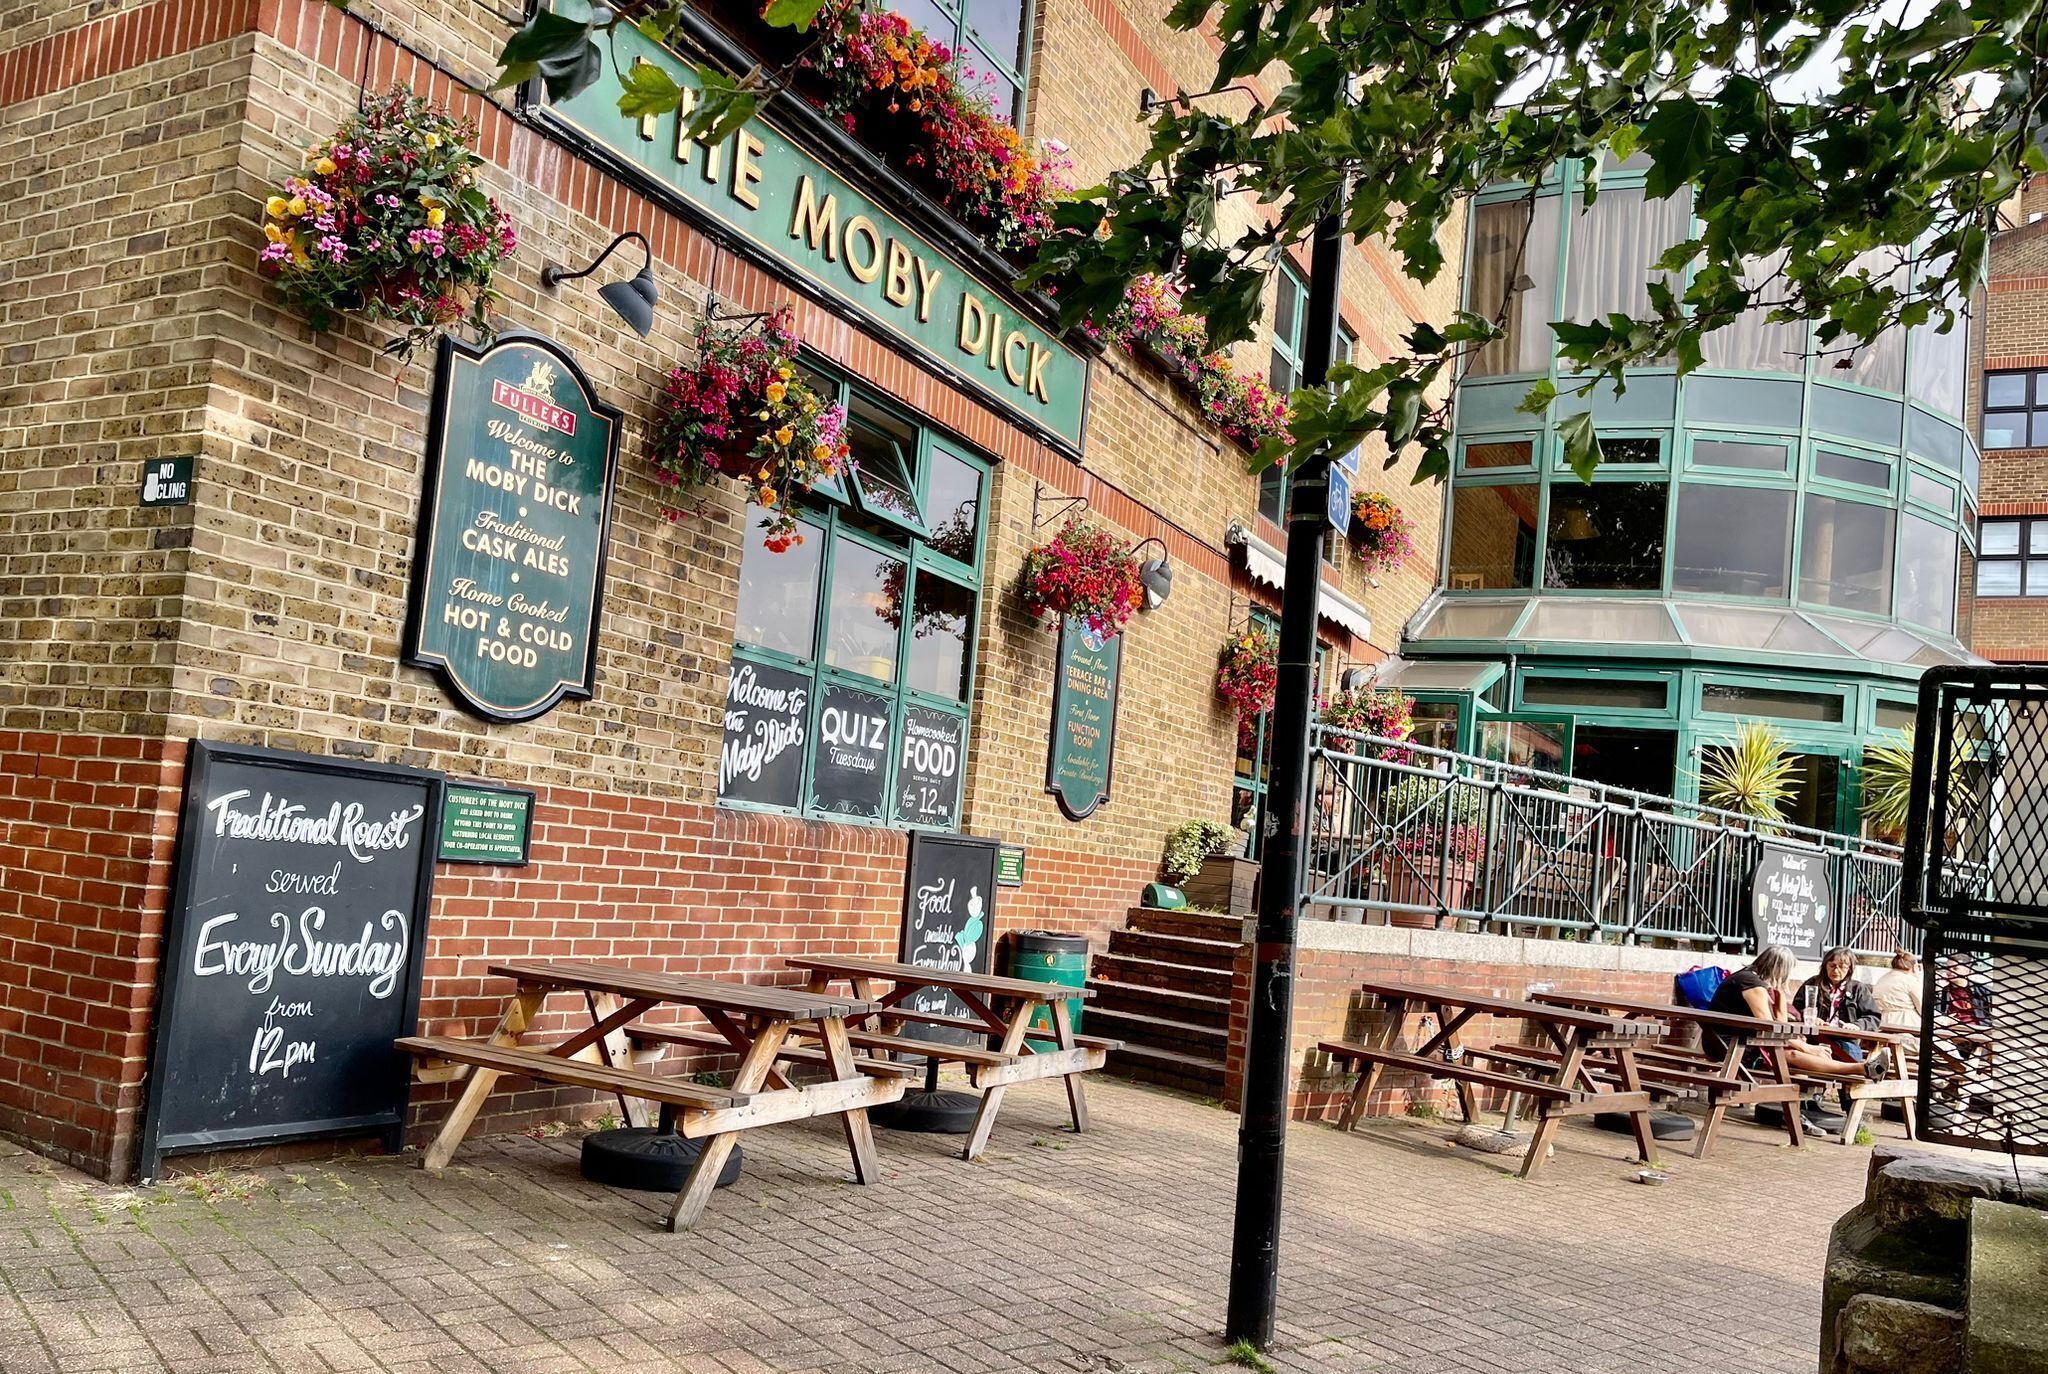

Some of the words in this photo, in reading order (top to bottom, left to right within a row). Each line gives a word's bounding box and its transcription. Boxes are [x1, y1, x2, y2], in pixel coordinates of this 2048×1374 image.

[789, 175, 942, 323] MOBY
[957, 292, 1052, 404] DICK
[498, 384, 570, 430] FULLER'S
[487, 419, 557, 460] Welcome
[558, 449, 575, 466] to
[160, 463, 175, 479] NO
[510, 449, 547, 480] THE
[156, 482, 186, 499] CLING
[465, 458, 528, 496] MOBY
[533, 482, 581, 516] DICK
[475, 510, 566, 551] Traditional
[462, 529, 516, 563] CASK
[523, 548, 569, 577] ALES
[448, 577, 504, 608] Home
[507, 593, 569, 624] Cooked
[443, 603, 490, 633] HOT
[497, 617, 511, 638] &
[519, 622, 573, 652] COLD
[478, 637, 537, 668] FOOD
[1071, 649, 1093, 666] Ground
[727, 665, 788, 713] Welcome
[788, 687, 806, 715] to
[1066, 665, 1092, 682] TERRACE
[1094, 675, 1106, 687] BAR
[1068, 678, 1091, 694] DINING
[1093, 687, 1108, 700] AREA
[725, 710, 748, 732] the
[821, 707, 887, 750] QUIZ
[907, 719, 957, 744] Homecooked
[1068, 721, 1100, 739] FUNCTION
[720, 720, 768, 795] Moby
[764, 717, 804, 764] Dick
[903, 736, 956, 777] FOOD
[1073, 735, 1093, 749] ROOM
[829, 746, 877, 774] Tuesdays
[448, 795, 478, 805] CUSTOMERS
[480, 798, 487, 806] OF
[488, 799, 497, 807] THE
[498, 800, 514, 809] MOBY
[514, 802, 526, 810] DICK
[207, 790, 341, 847] Traditional
[341, 802, 424, 862] Roast
[454, 819, 471, 827] BEYOND
[472, 820, 482, 828] THIS
[483, 821, 496, 829] POINT
[503, 823, 516, 831] AVOID
[479, 832, 492, 840] LOCAL
[444, 841, 456, 849] YOUR
[457, 842, 488, 850] CO-OPERATION
[265, 861, 342, 895] served
[915, 878, 955, 930] Food
[924, 924, 953, 944] available
[194, 912, 292, 994] Every
[284, 907, 410, 999] Sunday
[264, 995, 314, 1032] from
